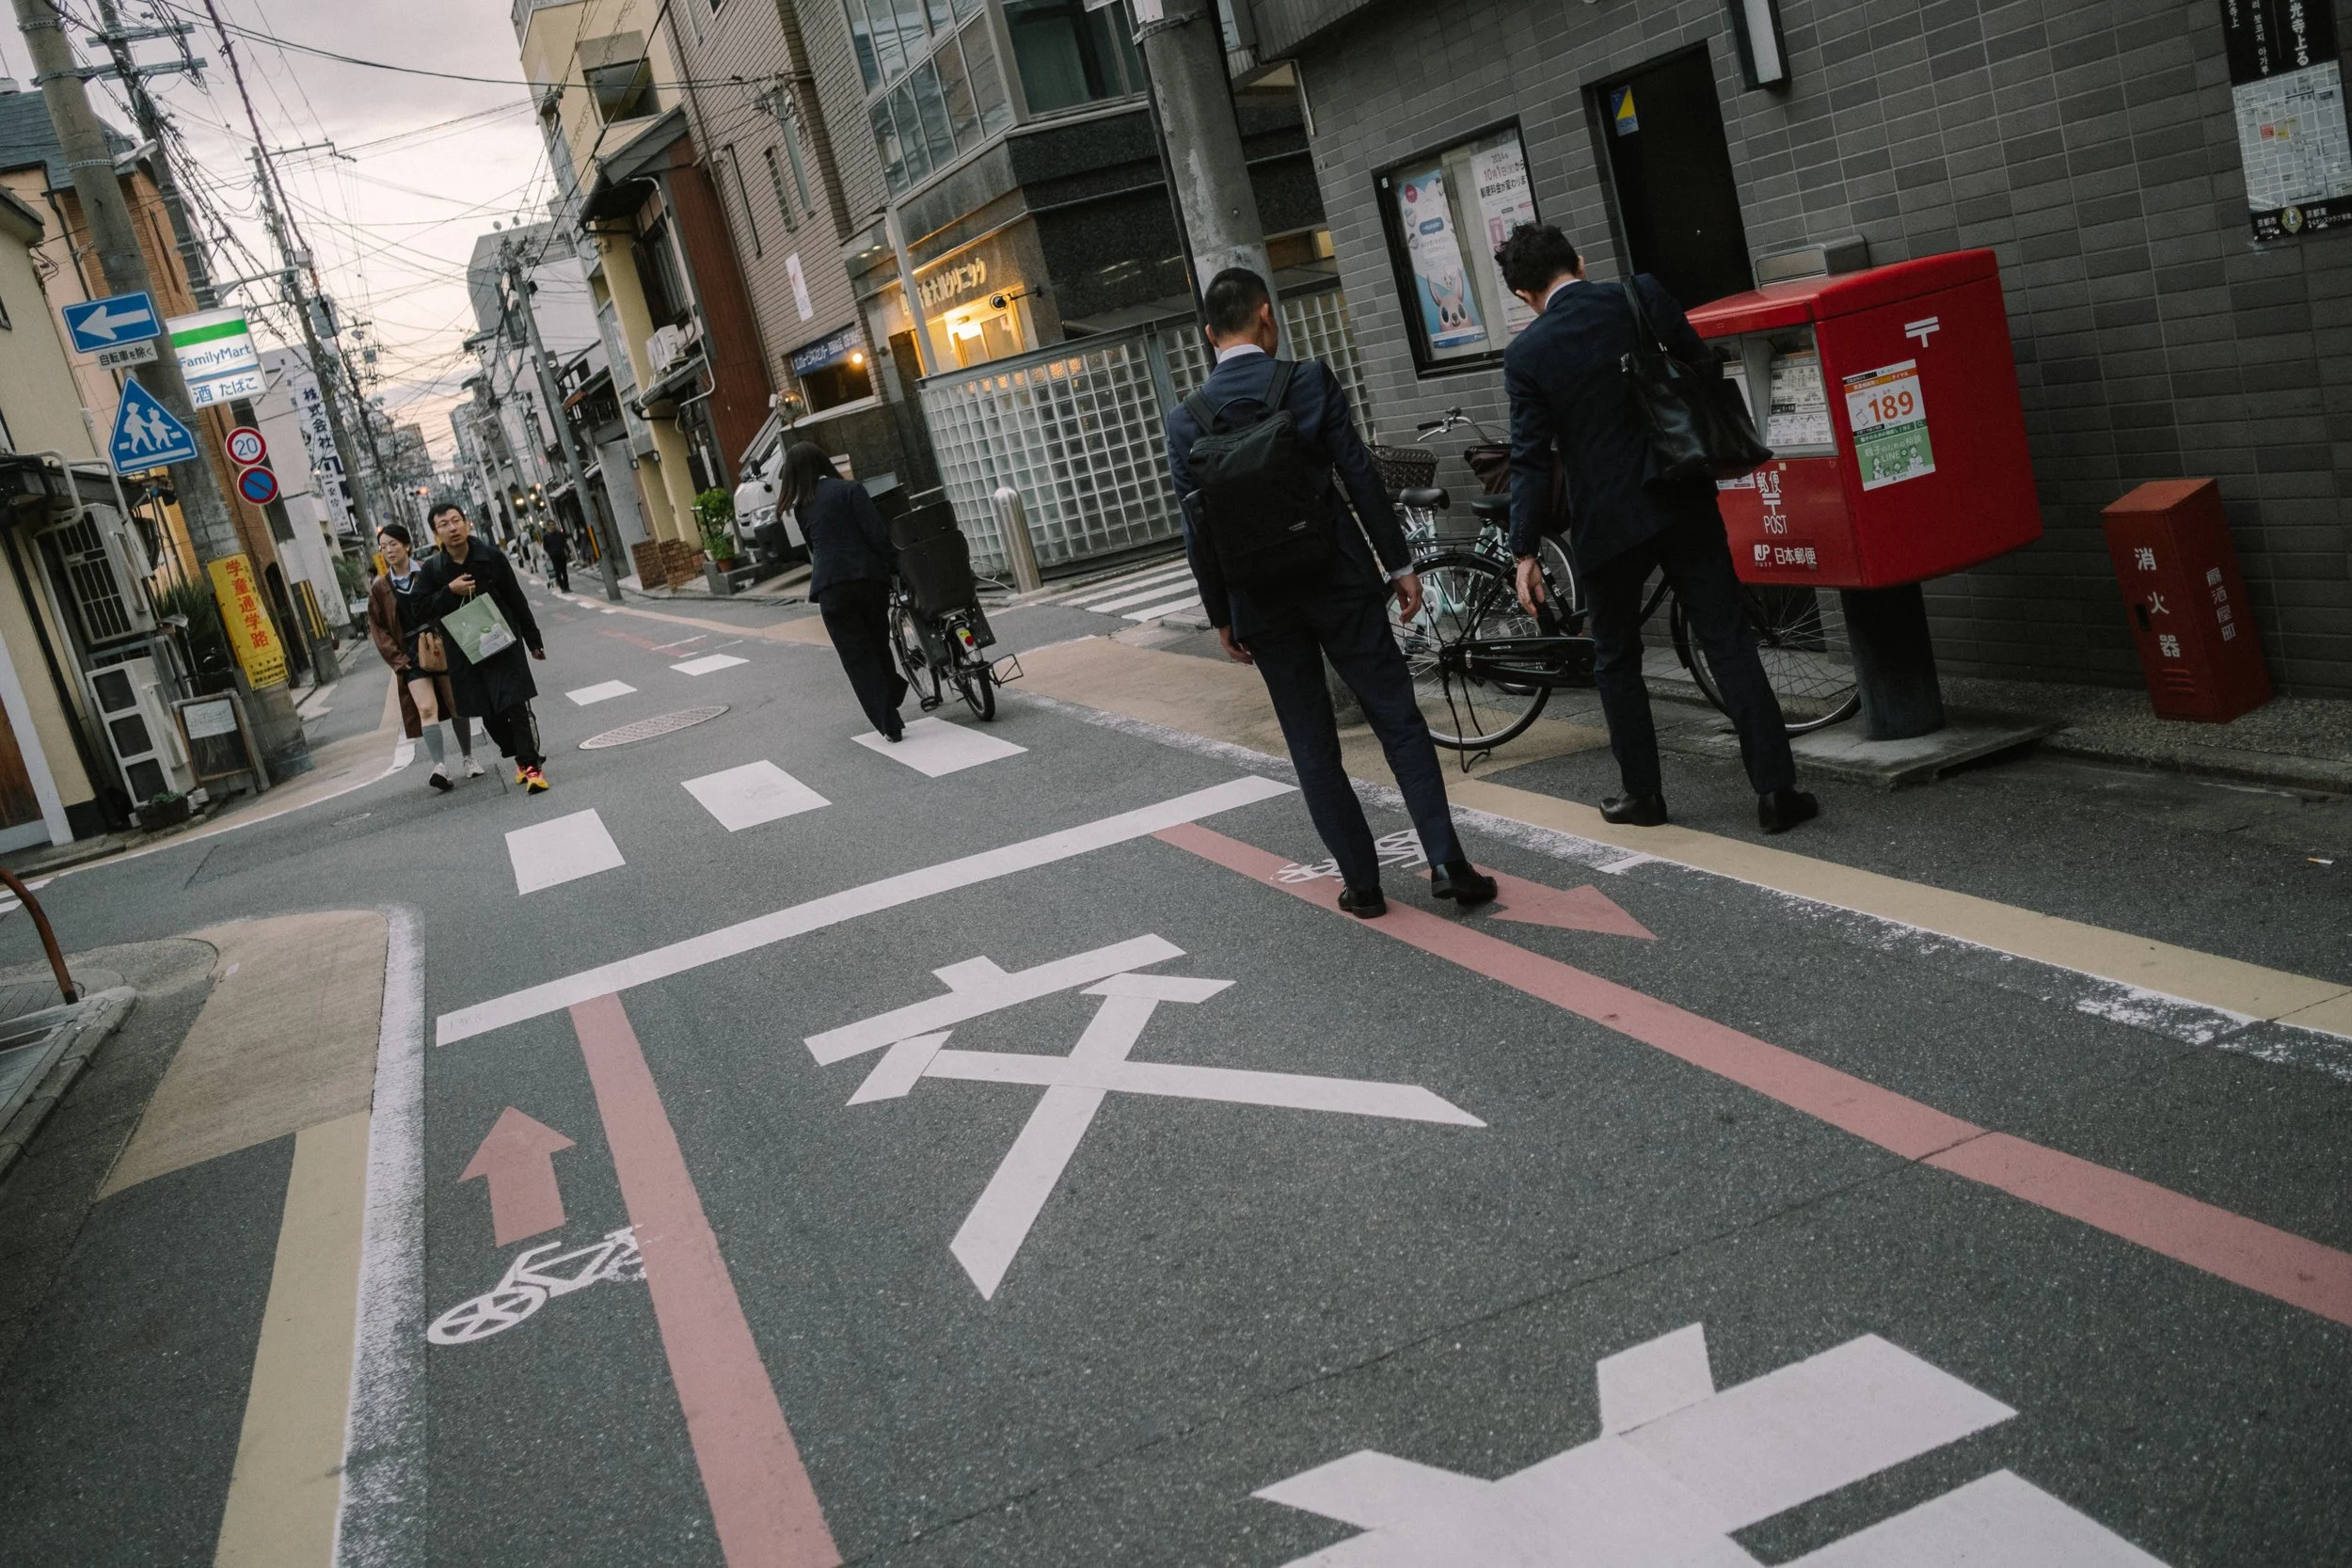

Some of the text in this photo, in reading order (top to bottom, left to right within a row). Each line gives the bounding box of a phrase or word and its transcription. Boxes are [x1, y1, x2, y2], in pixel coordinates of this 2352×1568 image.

[2289, 0, 2309, 66] 光寺上る
[1481, 175, 1527, 198] 郵便料金が変わりま
[99, 346, 154, 366] 自転車を除く
[180, 344, 252, 369] FamilyMart
[192, 377, 258, 404] 酒 たばこ
[1868, 390, 1914, 422] 189
[303, 388, 333, 449] 株式会社
[235, 437, 259, 456] 20
[1882, 451, 1900, 463] LINE
[1756, 471, 1782, 494] 郵便
[1763, 515, 1788, 534] POST
[1774, 547, 1817, 564] 日本郵便
[226, 559, 269, 649] 学童通学路
[2134, 547, 2181, 657] 消火器
